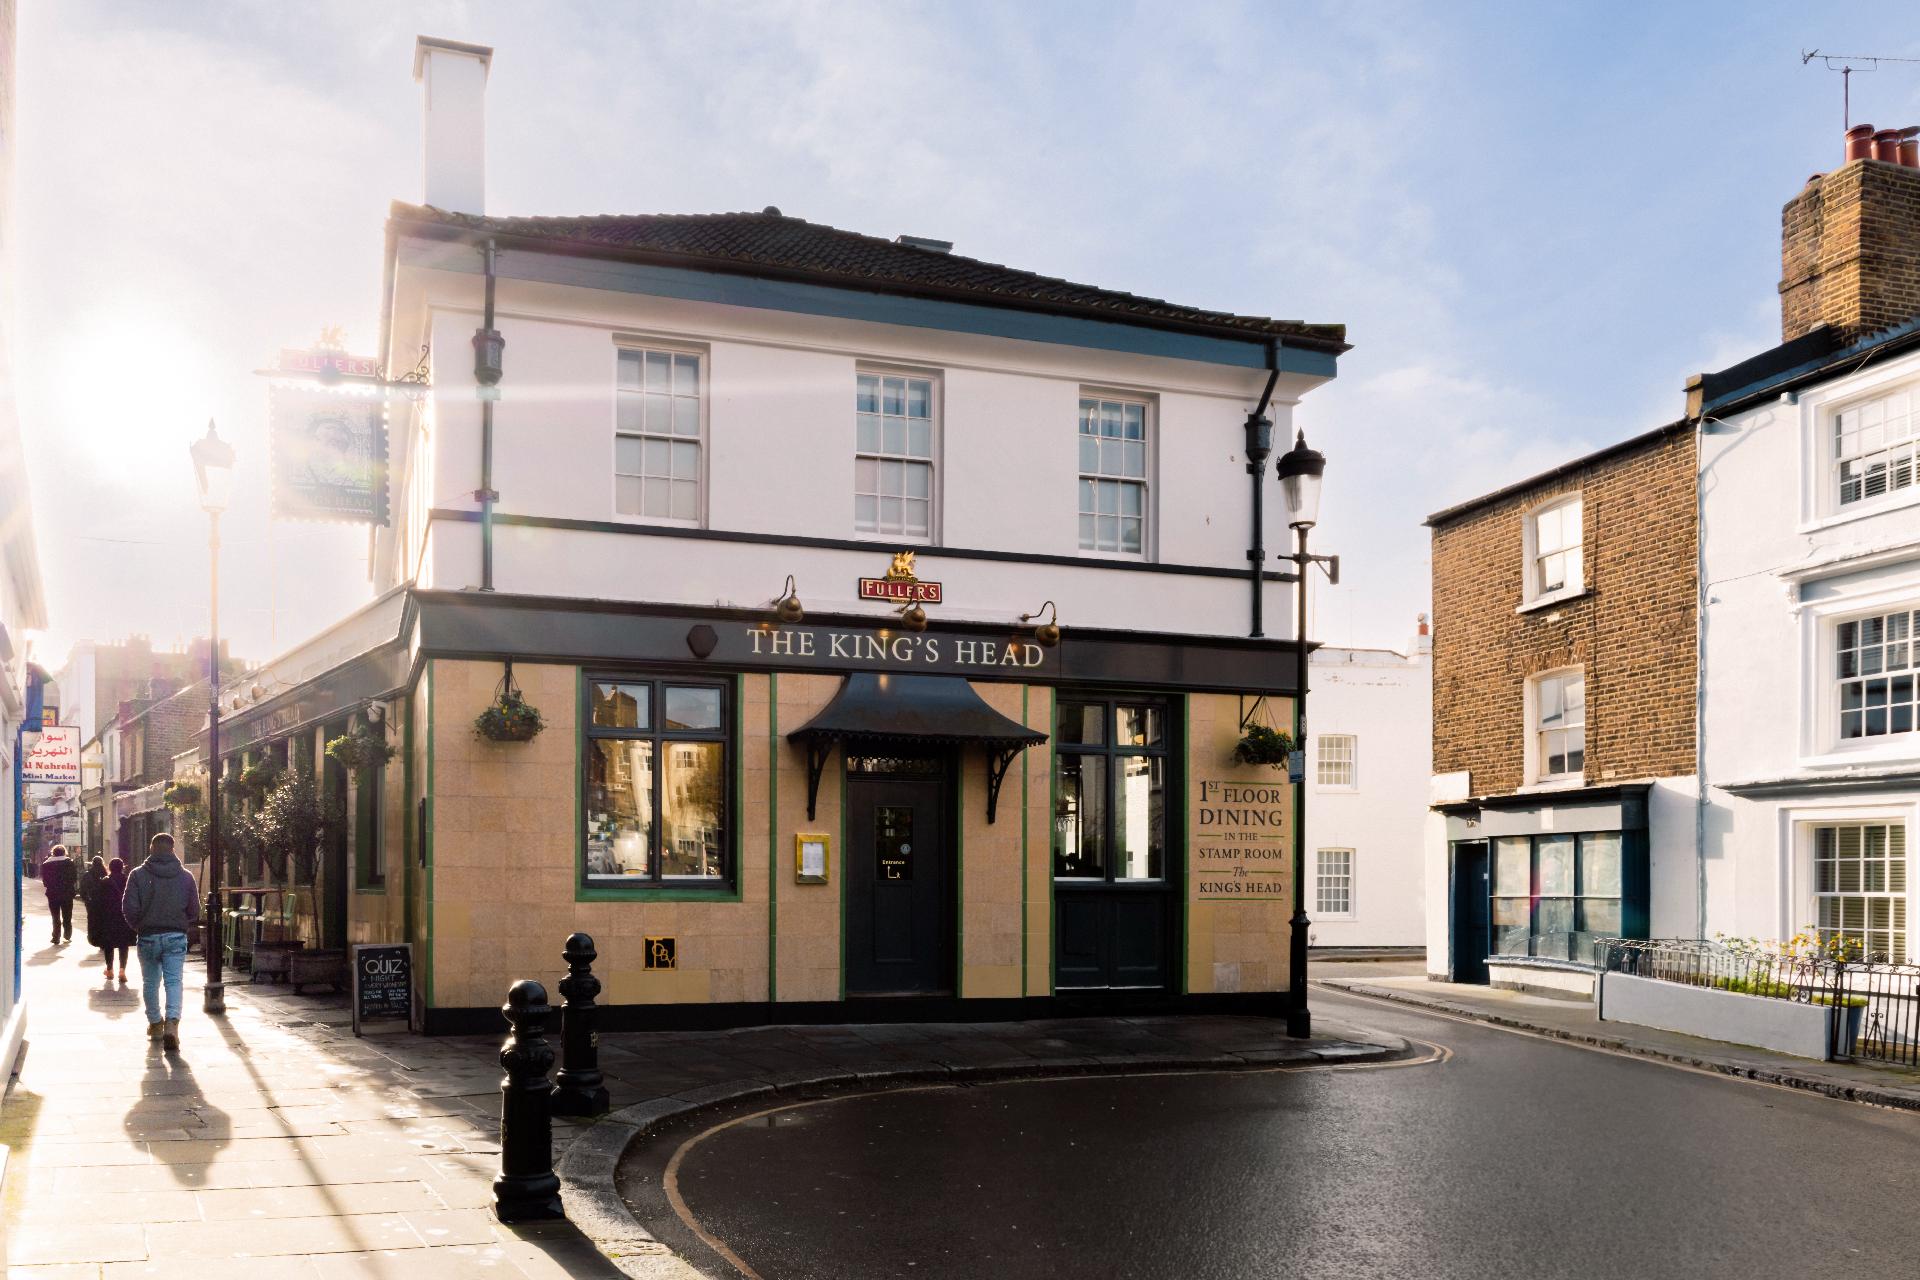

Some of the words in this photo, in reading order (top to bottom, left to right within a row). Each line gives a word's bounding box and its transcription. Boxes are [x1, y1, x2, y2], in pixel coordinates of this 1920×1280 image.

[865, 582, 937, 600] FULLER'S
[746, 629, 815, 656] THE
[829, 633, 939, 664] KING'S
[955, 640, 1044, 668] HEAD
[35, 761, 77, 770] Nahrein
[1199, 780, 1220, 802] 1ST
[1223, 788, 1281, 804] FLOOR
[1199, 808, 1282, 827] DINING
[1224, 832, 1236, 841] IN
[1238, 832, 1258, 841] THE
[1199, 847, 1241, 859] STAMP
[1244, 848, 1282, 860] ROOM
[1233, 866, 1249, 878] The
[1199, 880, 1241, 893] KING'S
[1246, 882, 1282, 893] HEAD
[365, 959, 403, 974] QUIZ
